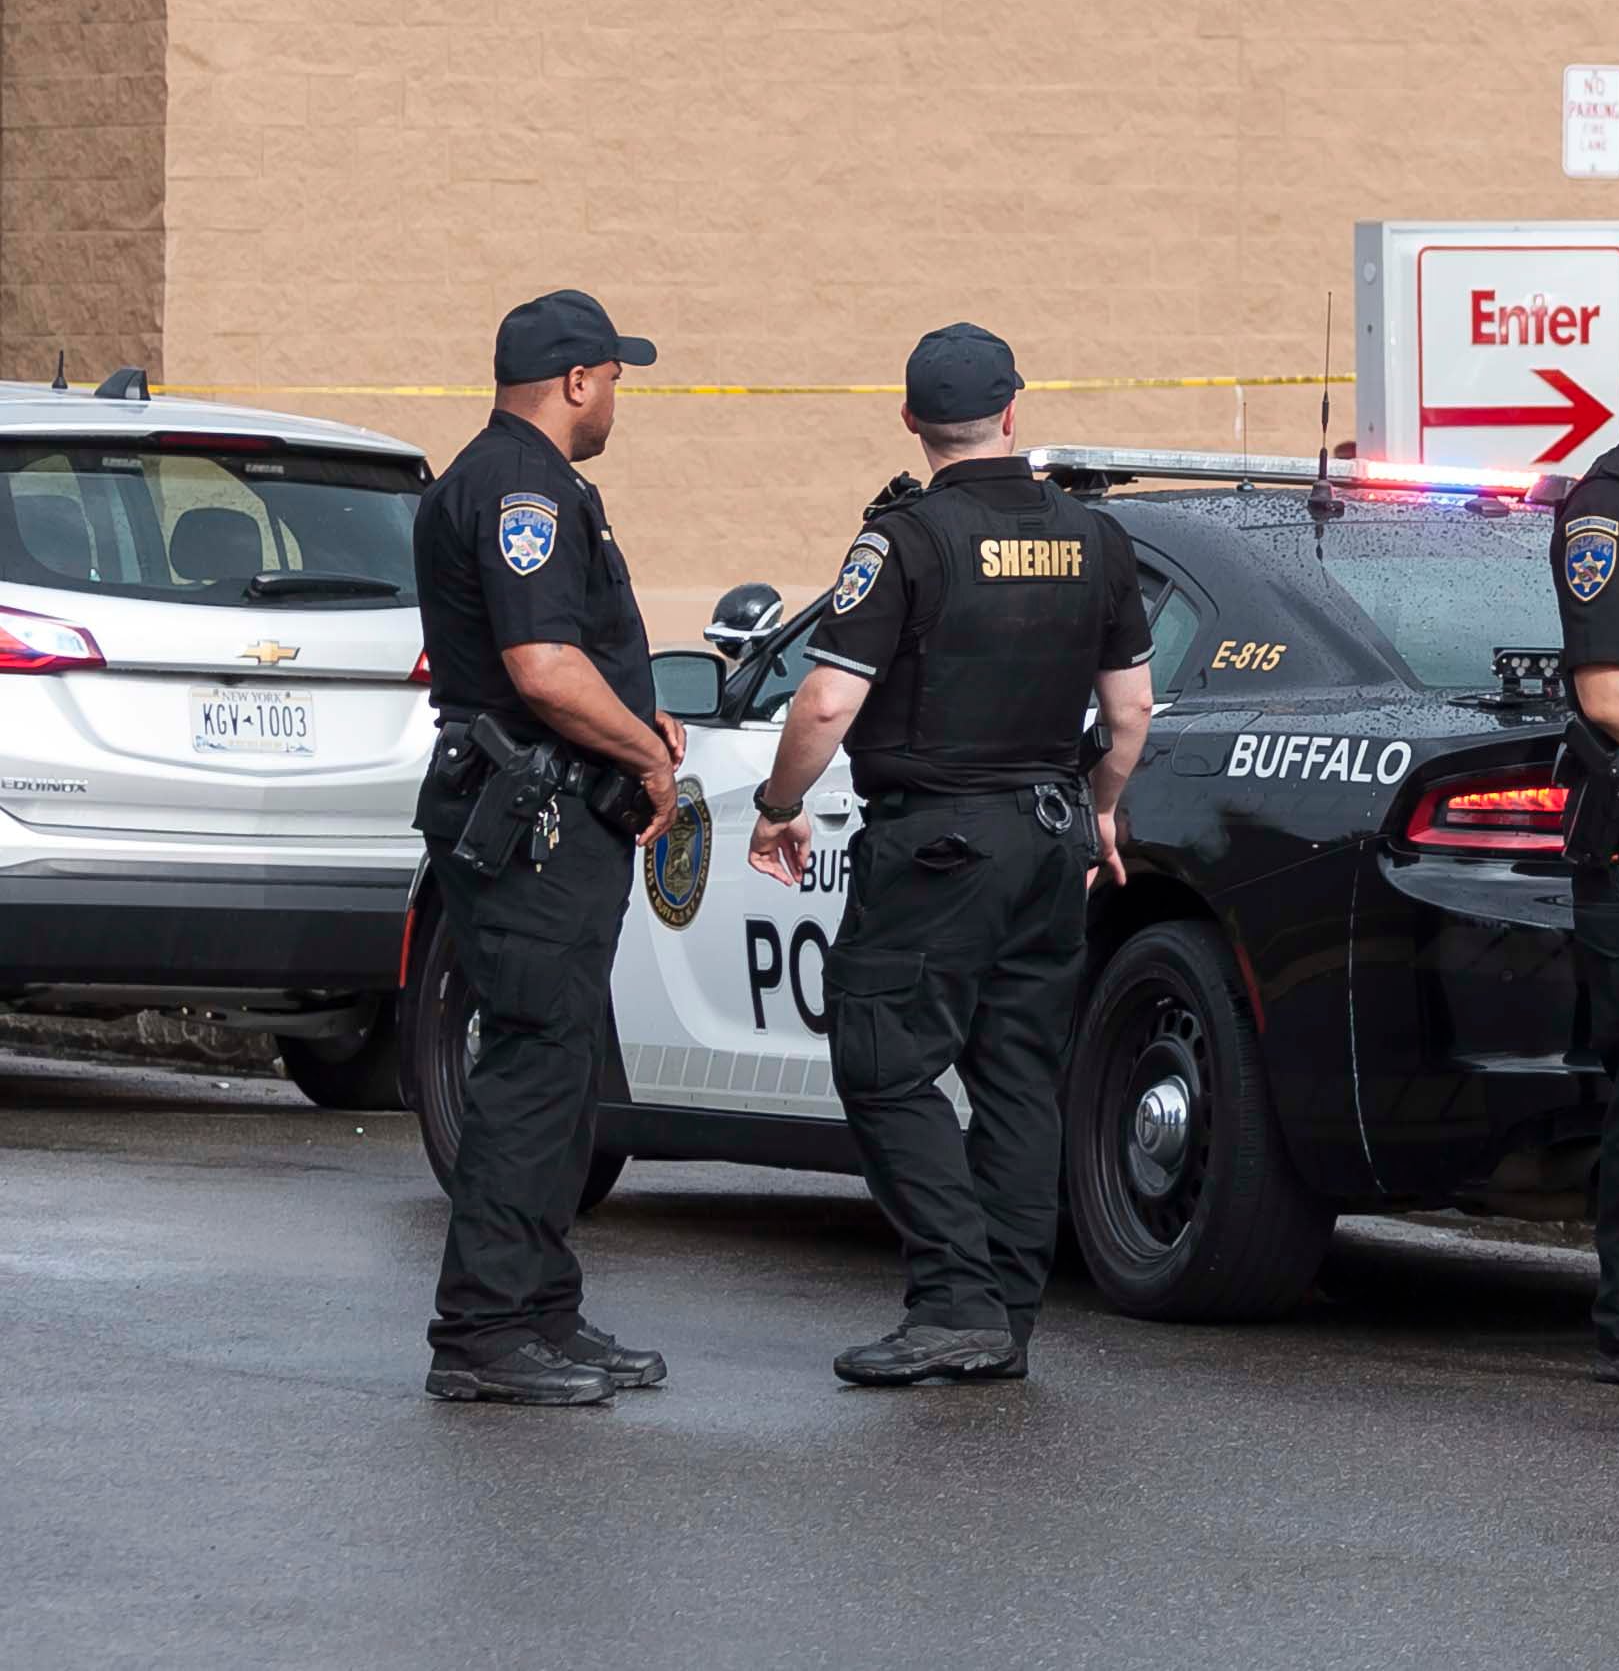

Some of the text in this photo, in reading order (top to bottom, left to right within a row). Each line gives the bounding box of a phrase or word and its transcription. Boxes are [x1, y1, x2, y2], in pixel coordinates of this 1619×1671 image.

[1583, 77, 1606, 96] NO
[1471, 289, 1601, 346] Enter
[980, 539, 1083, 578] SHERIFF
[1211, 640, 1287, 672] E-815
[222, 690, 282, 704] NEW YORK
[1227, 734, 1412, 785] BUFFALO
[1, 777, 89, 794] EQUINOX
